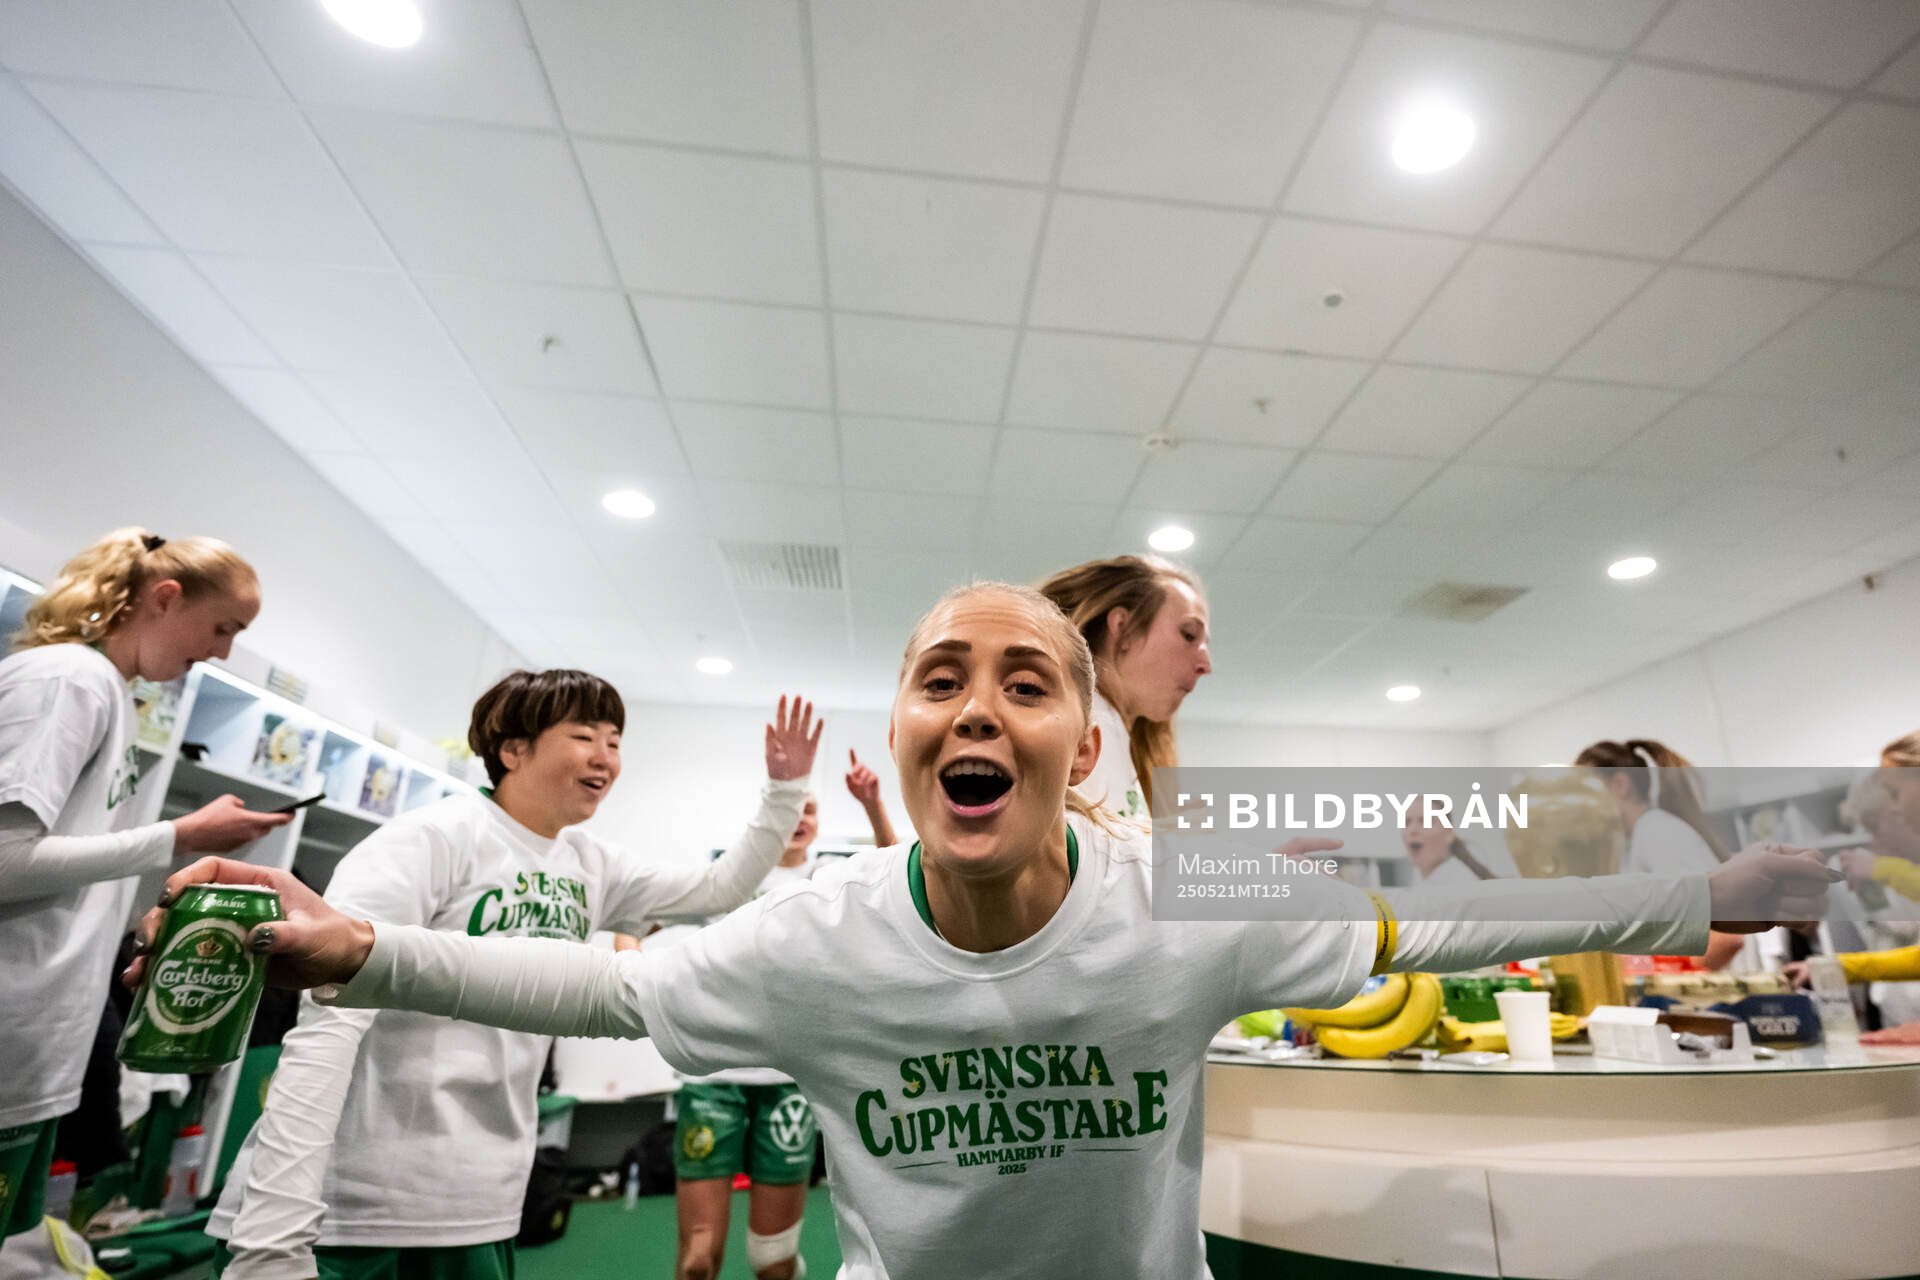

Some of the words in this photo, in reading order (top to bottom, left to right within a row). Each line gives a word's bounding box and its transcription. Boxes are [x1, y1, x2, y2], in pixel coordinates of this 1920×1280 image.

[155, 960, 245, 990] Carlsberg
[171, 991, 215, 1007] Hof
[900, 1045, 1115, 1098] SVENSKA
[855, 1069, 1168, 1157] CUPMÄSTARE
[956, 1146, 1047, 1167] HAMMARBY
[1050, 1144, 1066, 1157] IF
[997, 1163, 1027, 1176] 2025
